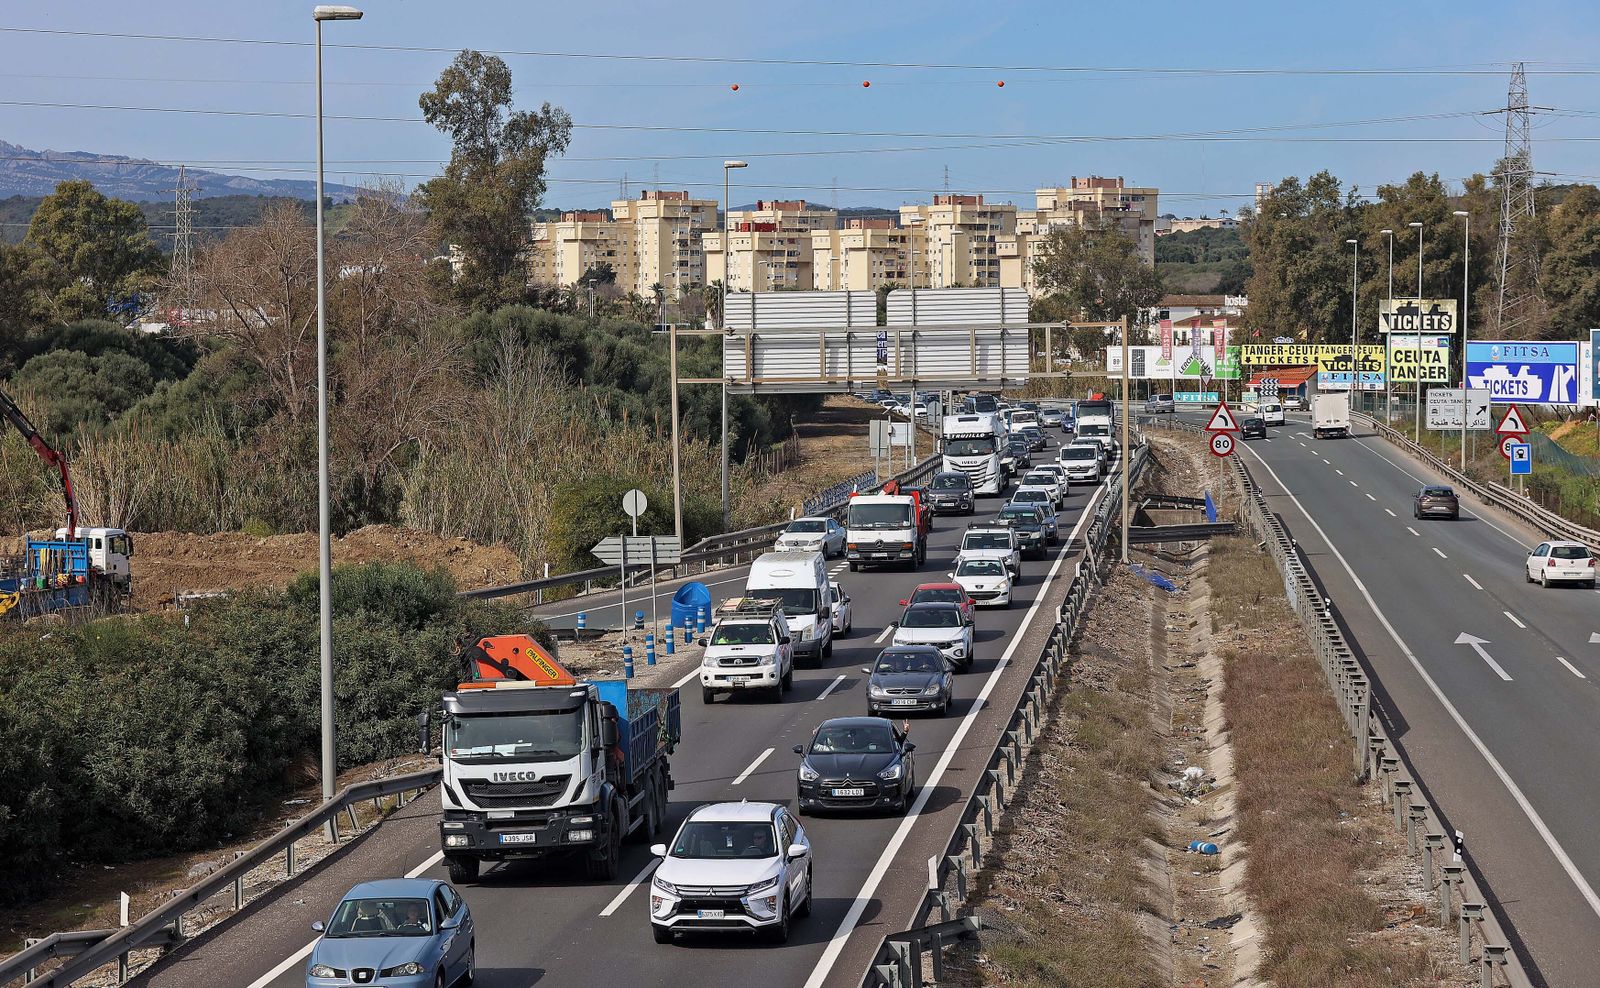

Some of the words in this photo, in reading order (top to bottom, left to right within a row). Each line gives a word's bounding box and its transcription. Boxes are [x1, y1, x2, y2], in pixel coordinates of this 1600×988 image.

[1391, 314, 1450, 330] TICKETS
[1244, 345, 1319, 355] TANGER-CEUTA
[1503, 346, 1550, 357] FITSA
[1256, 356, 1309, 364] TICKETS
[1394, 350, 1441, 363] CEUTA
[1178, 352, 1194, 374] LEROY
[1325, 361, 1380, 370] TICKETS
[1391, 365, 1447, 379] TANGER
[1483, 380, 1528, 396] TICKETS
[1215, 440, 1230, 449] 80
[1504, 443, 1511, 451] 8
[527, 649, 557, 679] PALFINGER
[493, 771, 536, 782] IVECO
